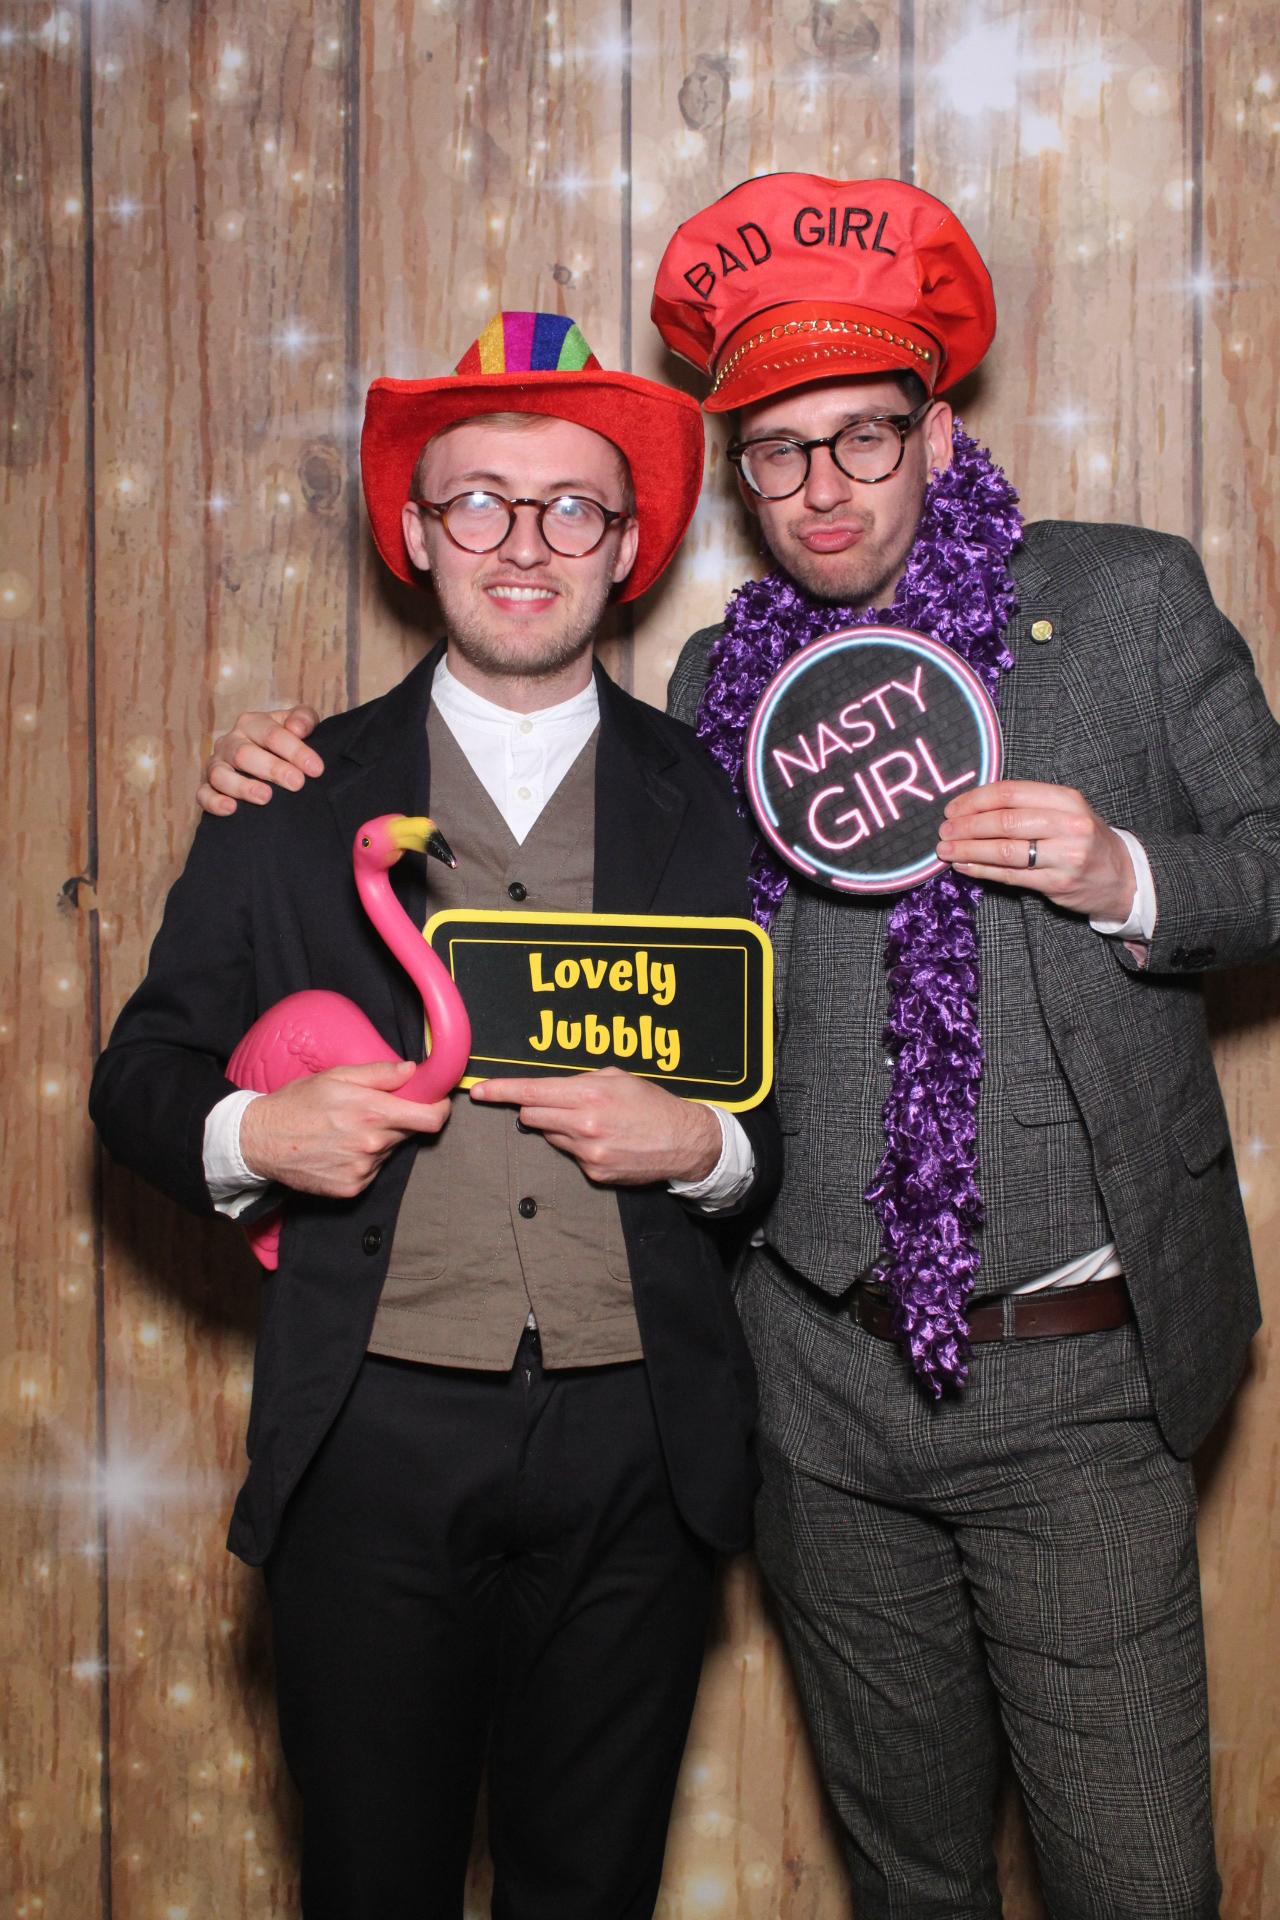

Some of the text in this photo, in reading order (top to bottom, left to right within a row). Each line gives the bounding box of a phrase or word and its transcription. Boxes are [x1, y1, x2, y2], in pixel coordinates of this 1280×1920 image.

[683, 207, 897, 300] BAD GIRL
[772, 665, 926, 788] NASTY
[808, 737, 976, 850] GIRL
[528, 951, 677, 1006] Lovely
[528, 1010, 682, 1072] Jubbly
